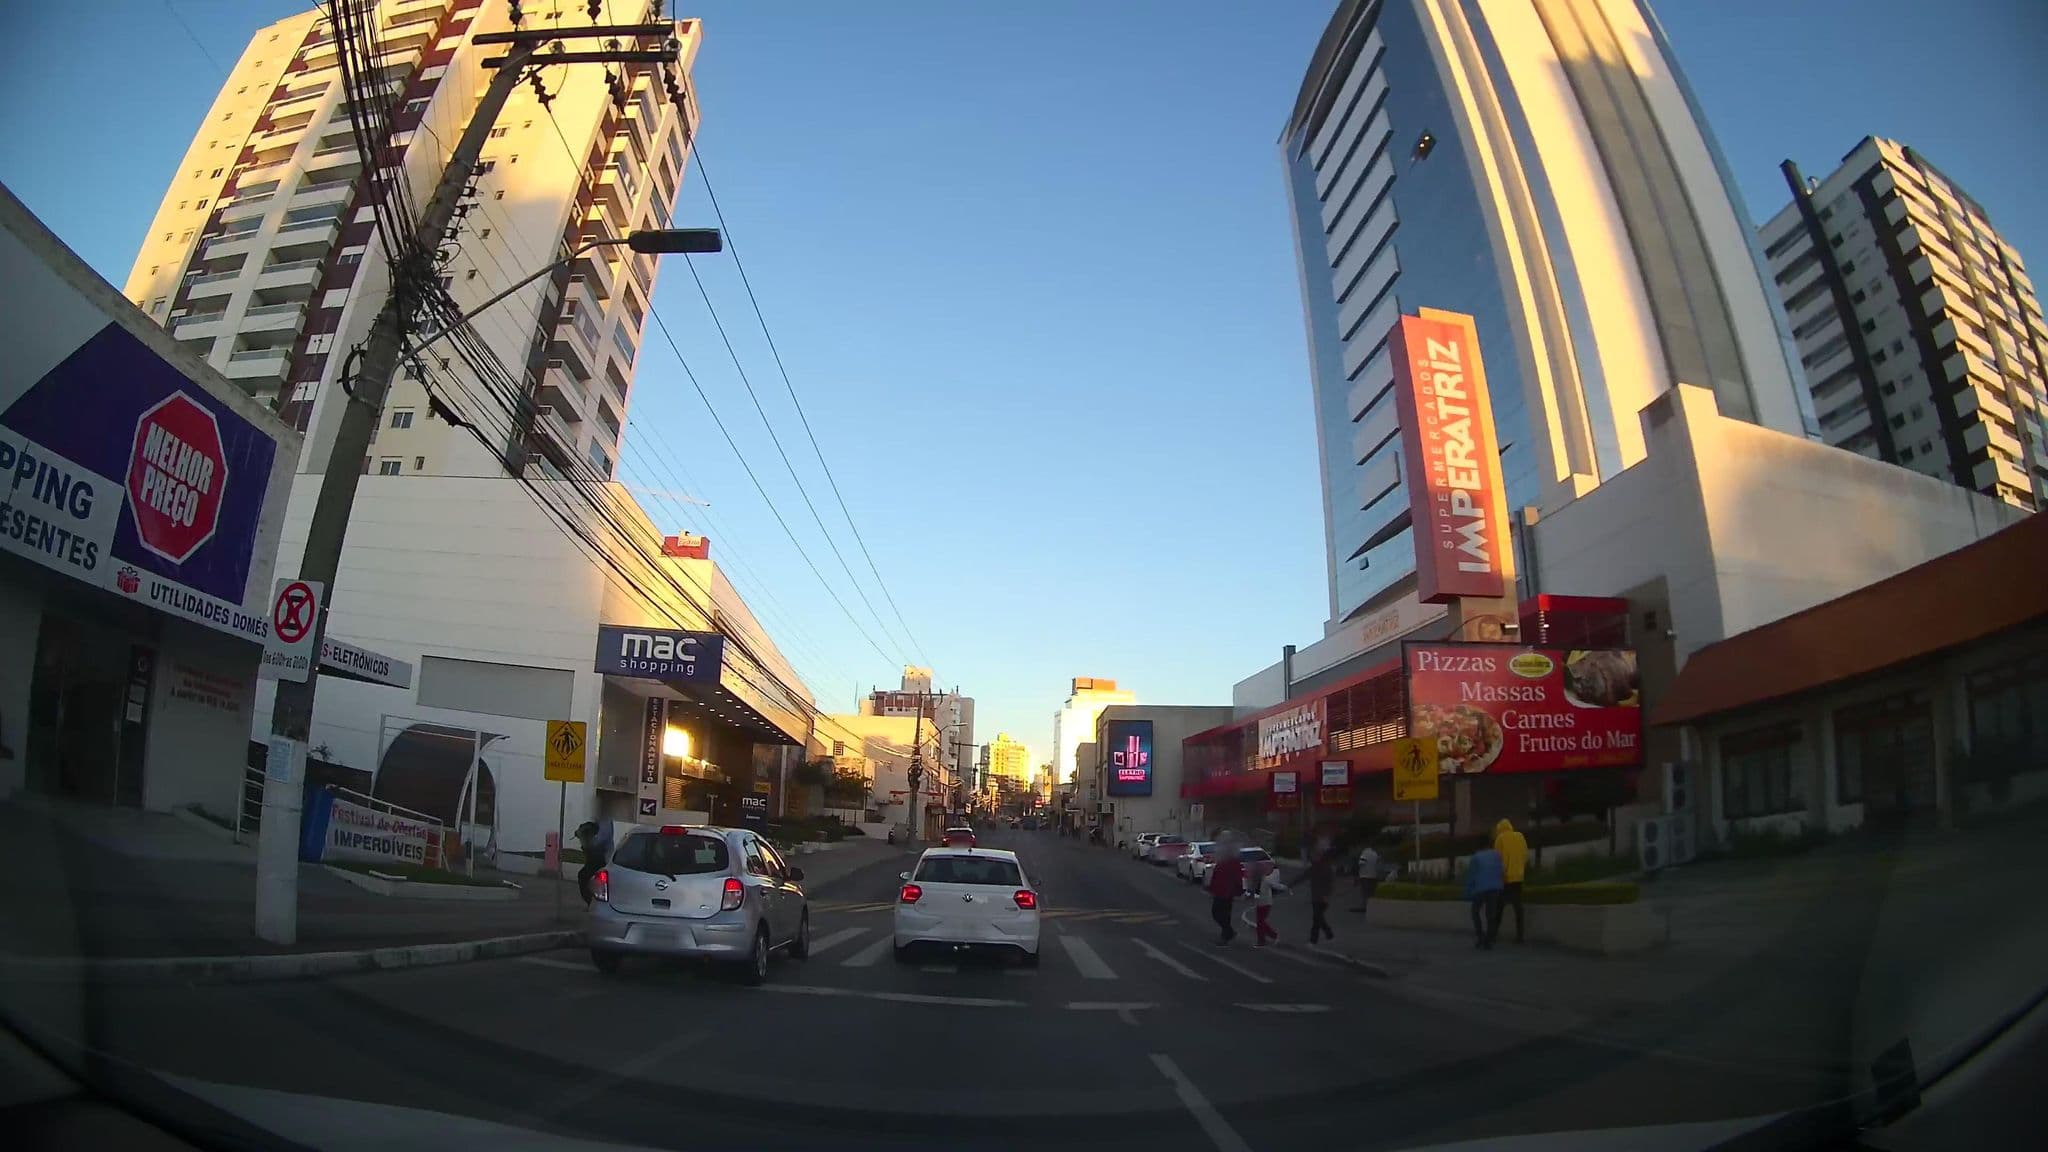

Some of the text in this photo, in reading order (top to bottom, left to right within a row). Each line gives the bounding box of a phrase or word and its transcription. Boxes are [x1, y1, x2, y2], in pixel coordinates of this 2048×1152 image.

[143, 421, 215, 495] MELHOR
[1418, 359, 1454, 550] SUPERMERCADOS
[1426, 336, 1492, 574] IMPERATRIZ
[140, 467, 199, 528] PREÇO
[150, 581, 230, 625] UTILIDADES
[620, 633, 697, 662] mac
[620, 658, 695, 676] shopping
[1417, 651, 1496, 673] Pizzas
[1461, 681, 1546, 702] Massas
[1501, 710, 1575, 730] Carnes
[1519, 730, 1636, 753] Frutos do Mar
[742, 797, 766, 807] mac
[331, 803, 375, 829] Festival
[334, 829, 425, 861] IMPERDÍVEIS
